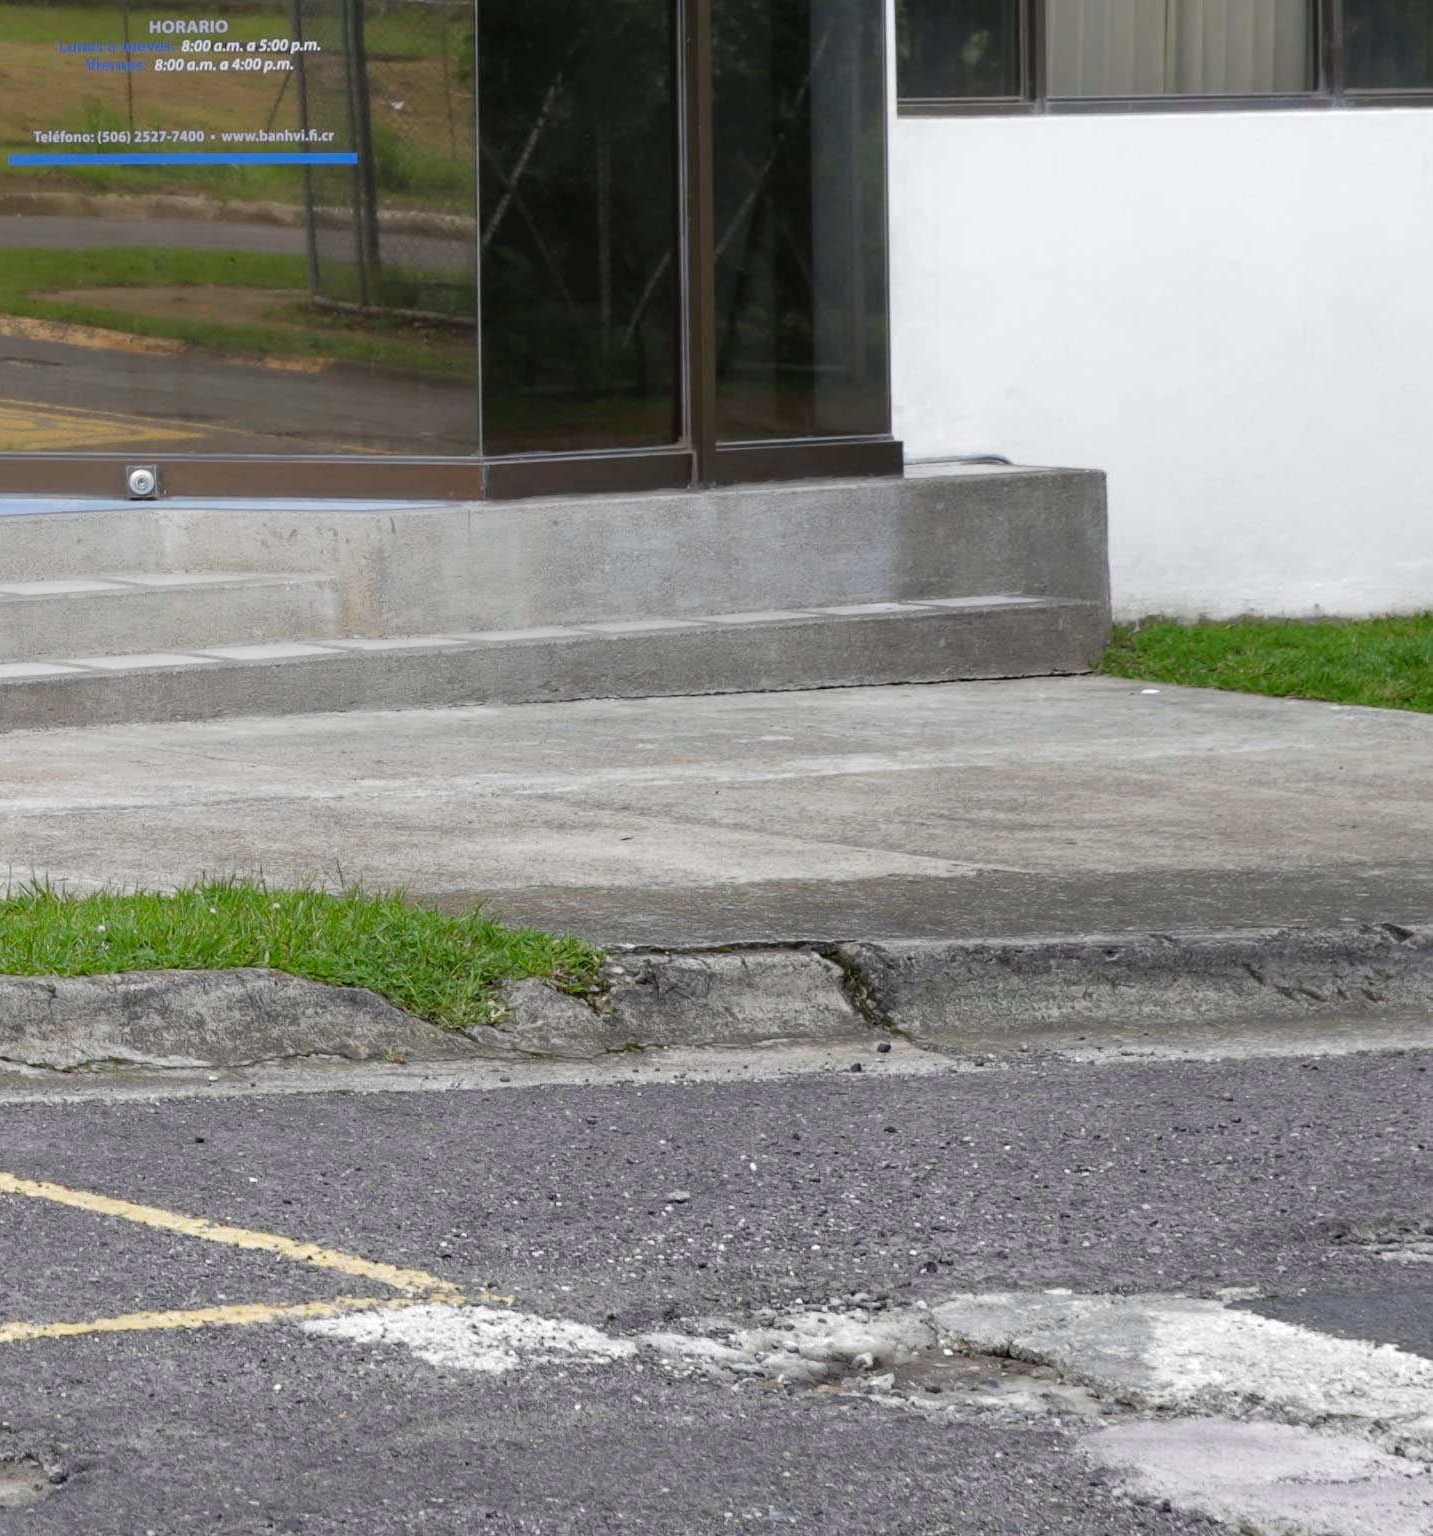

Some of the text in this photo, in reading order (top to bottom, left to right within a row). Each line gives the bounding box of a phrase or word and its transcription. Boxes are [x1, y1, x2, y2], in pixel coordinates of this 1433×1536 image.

[148, 20, 229, 34] HORARIO
[181, 39, 211, 52] 8:00
[213, 41, 244, 52] a.m.
[246, 41, 256, 52] a
[258, 39, 289, 52] 5:00
[290, 41, 321, 54] p.m.
[154, 59, 184, 71] 8:00
[186, 60, 217, 71] a.m.
[219, 60, 229, 71] a
[231, 58, 262, 71] 4:00
[263, 59, 294, 73] p.m.
[33, 129, 335, 144] Teléfono: (506) 2527-7400 www.banhvi.fi.cr
